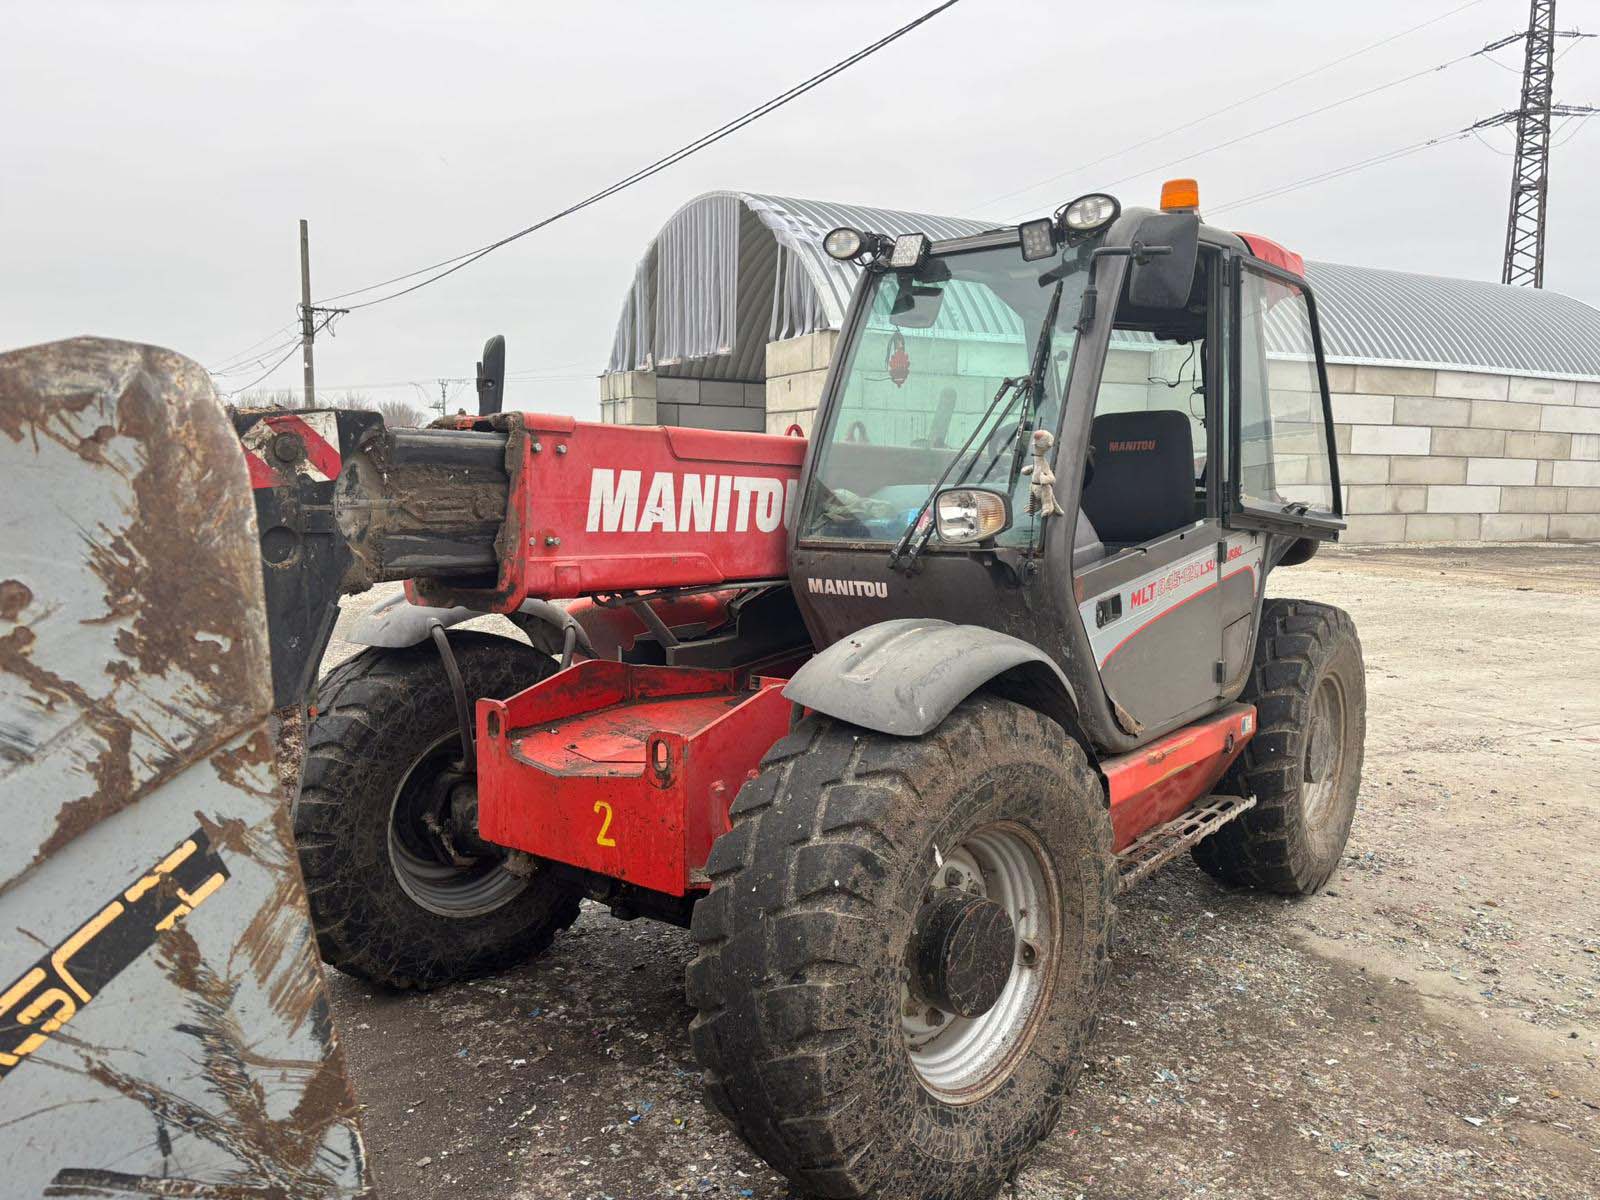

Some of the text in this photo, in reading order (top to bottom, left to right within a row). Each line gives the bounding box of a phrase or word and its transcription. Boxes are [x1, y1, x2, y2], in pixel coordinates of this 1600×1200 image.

[1108, 439, 1156, 453] MANITOU
[807, 577, 888, 598] MANITOU
[1131, 582, 1157, 609] MLT
[1199, 559, 1216, 577] LSU
[593, 800, 616, 847] 2
